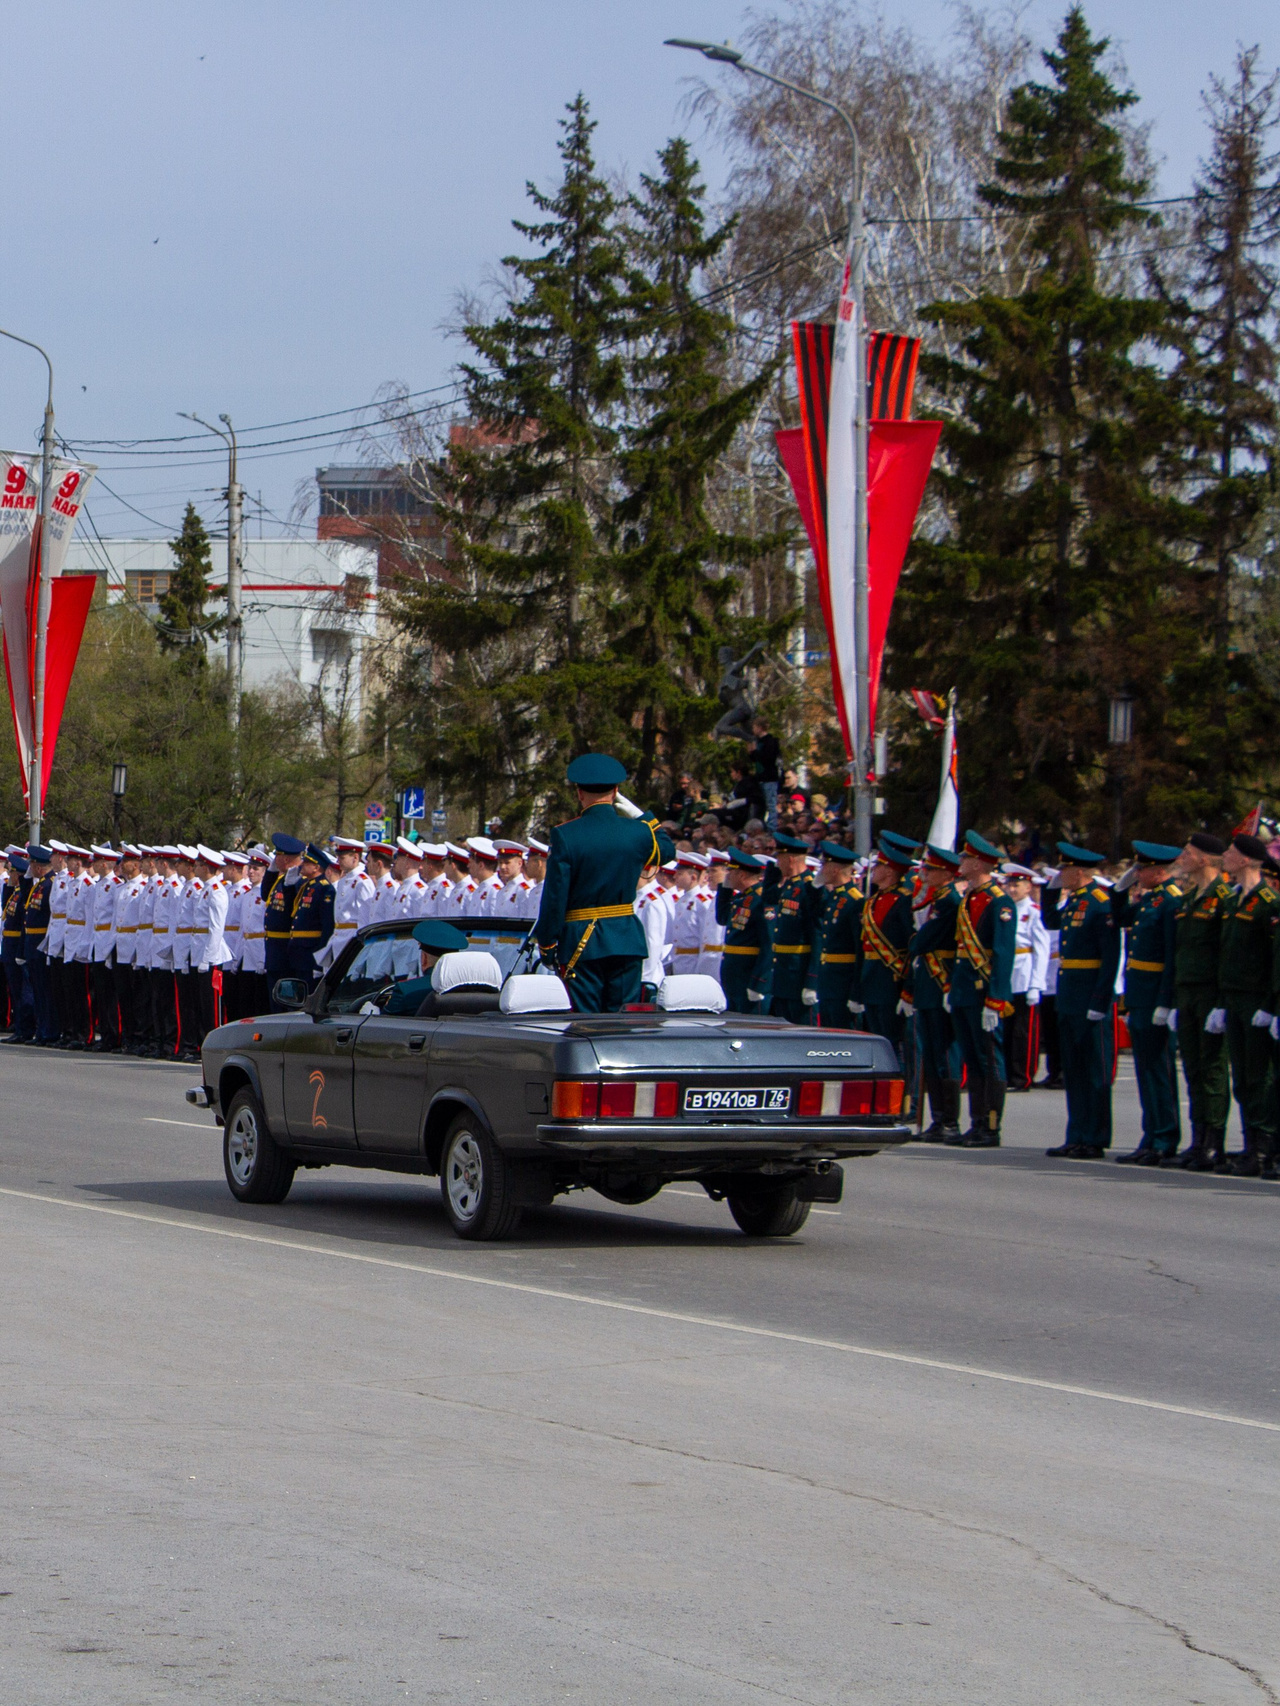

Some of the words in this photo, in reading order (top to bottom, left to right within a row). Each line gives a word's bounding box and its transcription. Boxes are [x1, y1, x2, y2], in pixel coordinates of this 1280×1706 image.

[4, 465, 28, 493] 9
[58, 470, 80, 498] 9
[0, 494, 37, 510] МАЯ
[51, 496, 79, 518] МАЯ
[369, 832, 380, 842] P
[770, 1090, 785, 1101] 76
